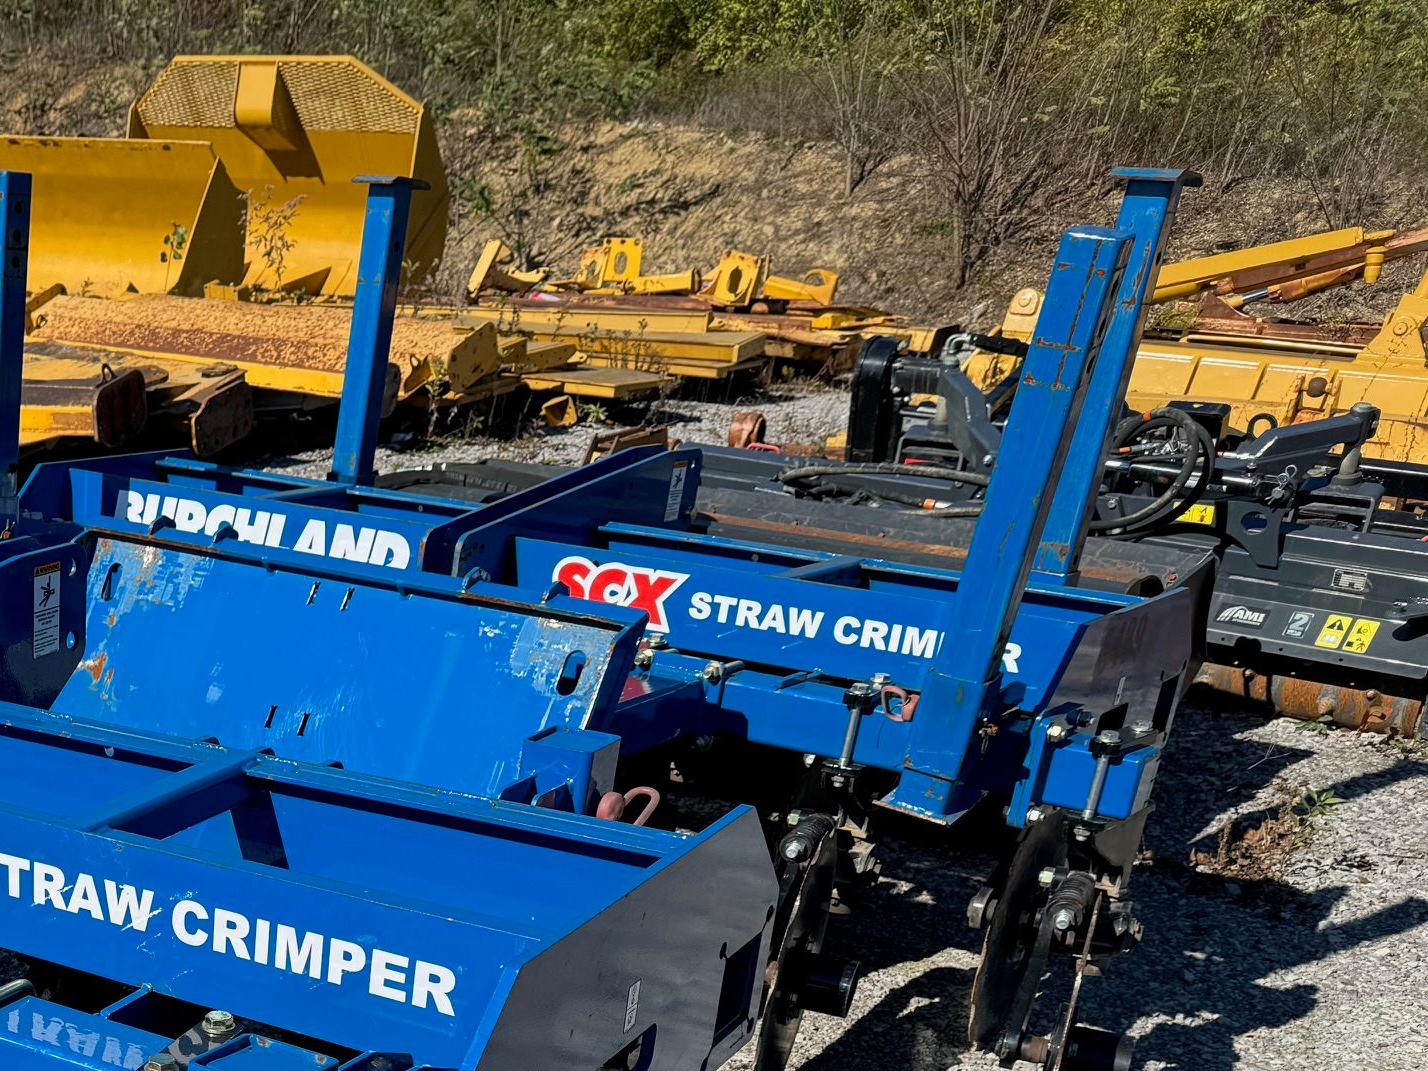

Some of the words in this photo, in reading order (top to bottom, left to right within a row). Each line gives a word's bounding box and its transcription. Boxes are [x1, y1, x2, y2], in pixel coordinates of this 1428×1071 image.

[552, 556, 690, 633] SCX
[689, 591, 823, 638] STRAW
[833, 615, 1022, 673] CRIMR
[1232, 609, 1266, 622] AMI
[1289, 613, 1310, 631] 2
[172, 900, 457, 1017] CRIMPER
